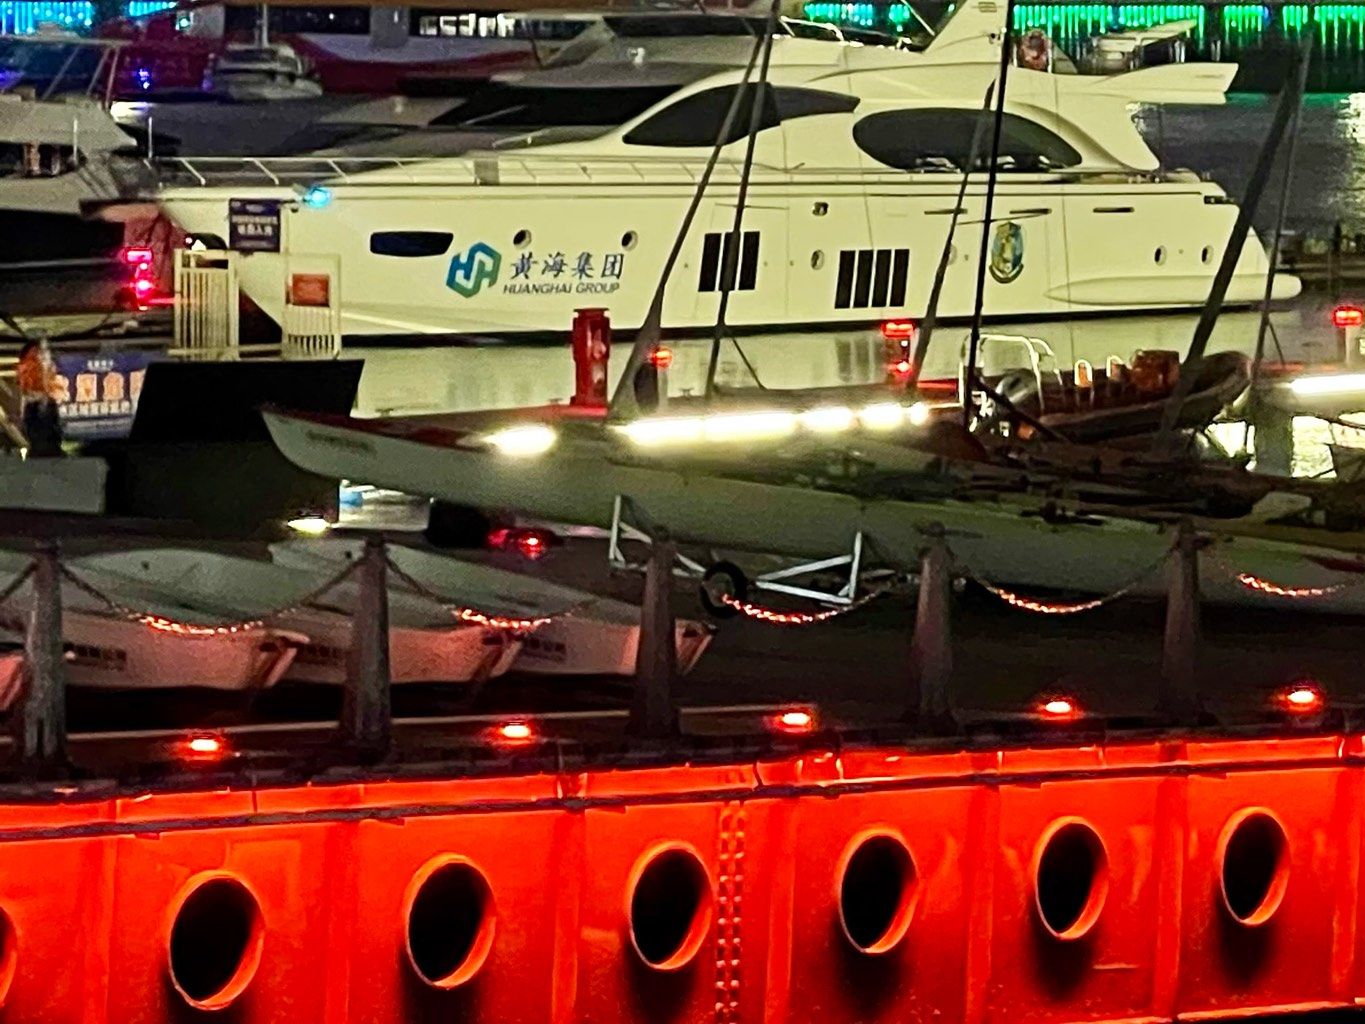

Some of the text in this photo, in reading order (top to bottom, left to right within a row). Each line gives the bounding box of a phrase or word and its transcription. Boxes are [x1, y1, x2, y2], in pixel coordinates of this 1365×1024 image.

[510, 251, 625, 280] 黄海集团
[503, 282, 620, 295] HUANGHAI GROUP
